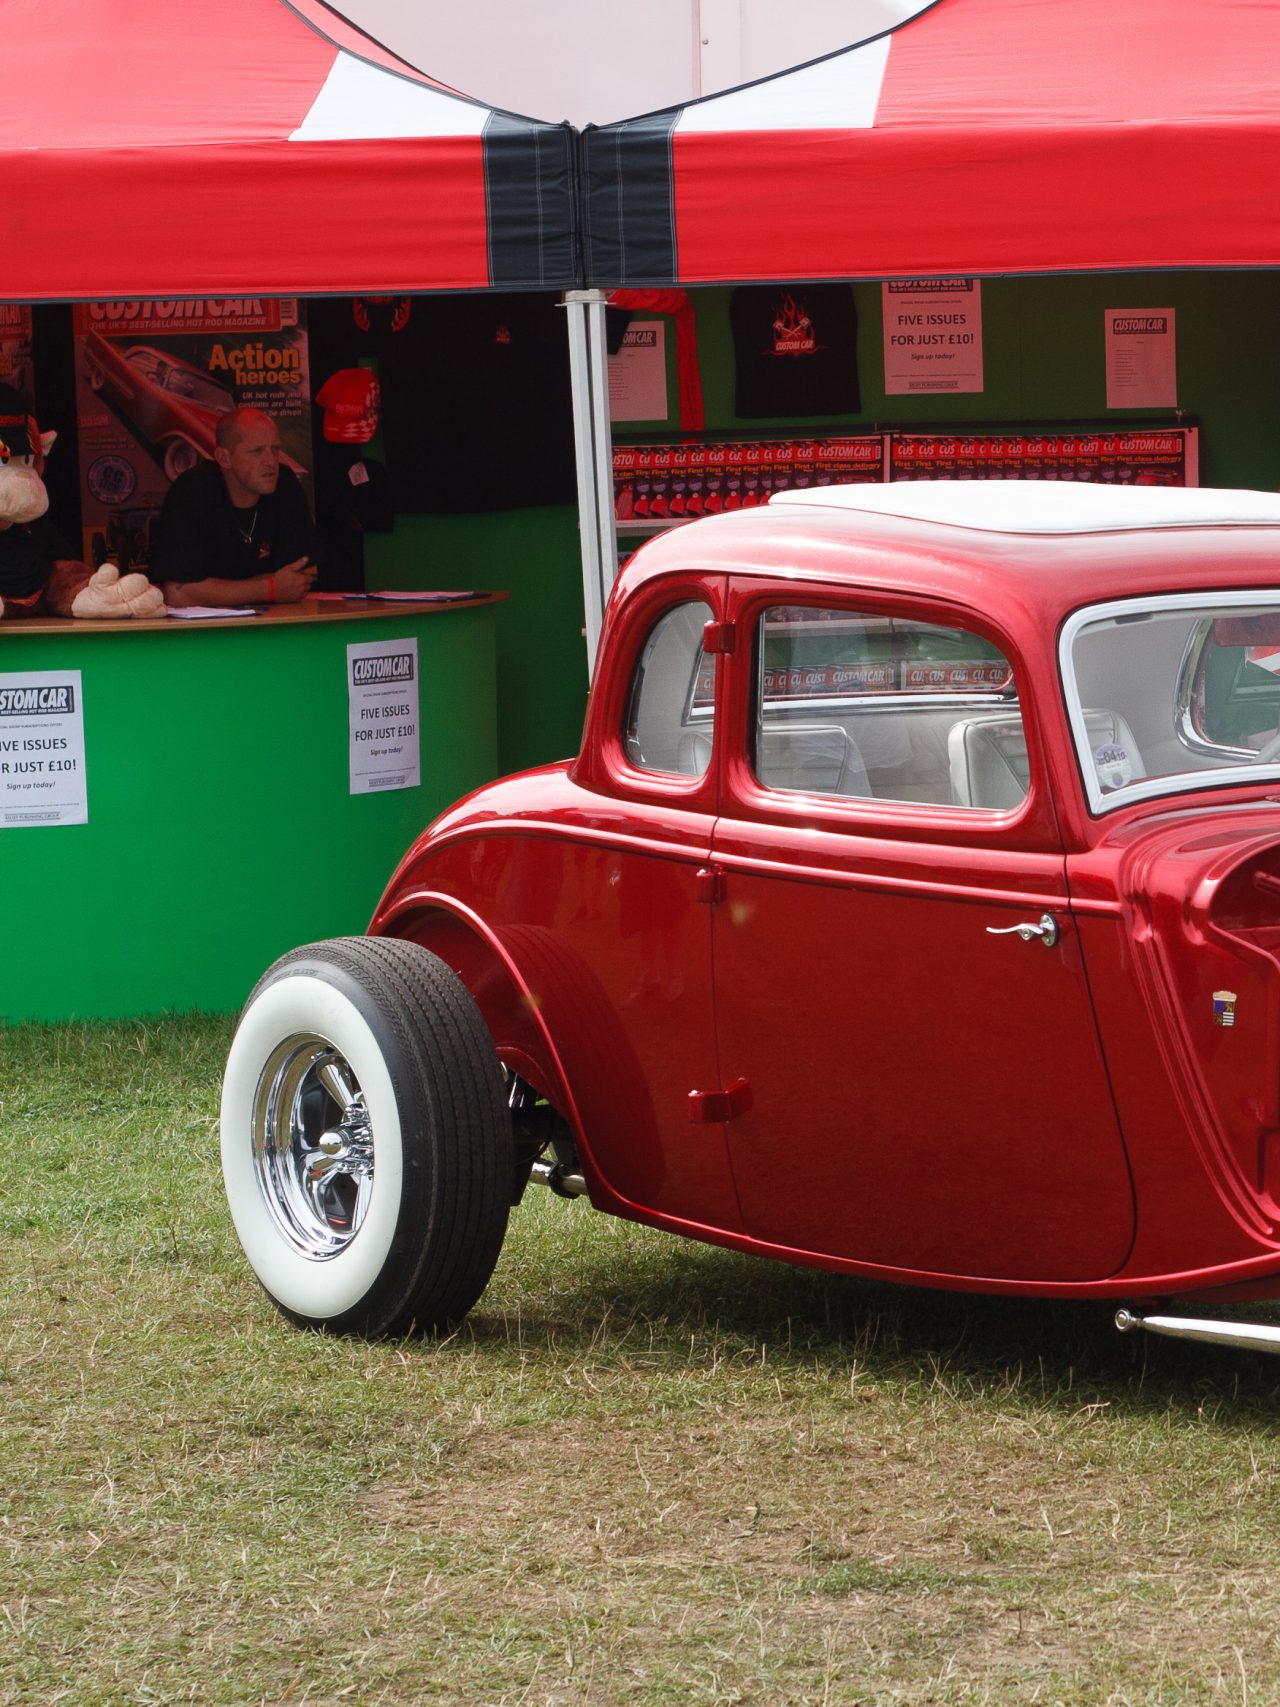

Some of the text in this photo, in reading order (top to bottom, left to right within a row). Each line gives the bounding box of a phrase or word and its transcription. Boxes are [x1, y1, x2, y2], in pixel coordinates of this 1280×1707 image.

[898, 314, 966, 326] FIVE ISSUES
[891, 333, 974, 346] FOR JUST £10!
[209, 343, 299, 371] Action
[235, 369, 301, 385] heroes
[361, 704, 410, 720] FIVE ISSUES
[355, 724, 415, 742] FOR JUST £10!
[23, 738, 67, 751] ISSUES
[14, 761, 44, 773] JUST
[48, 759, 77, 771] £10!
[6, 782, 21, 790] Sign
[33, 781, 56, 789] today!
